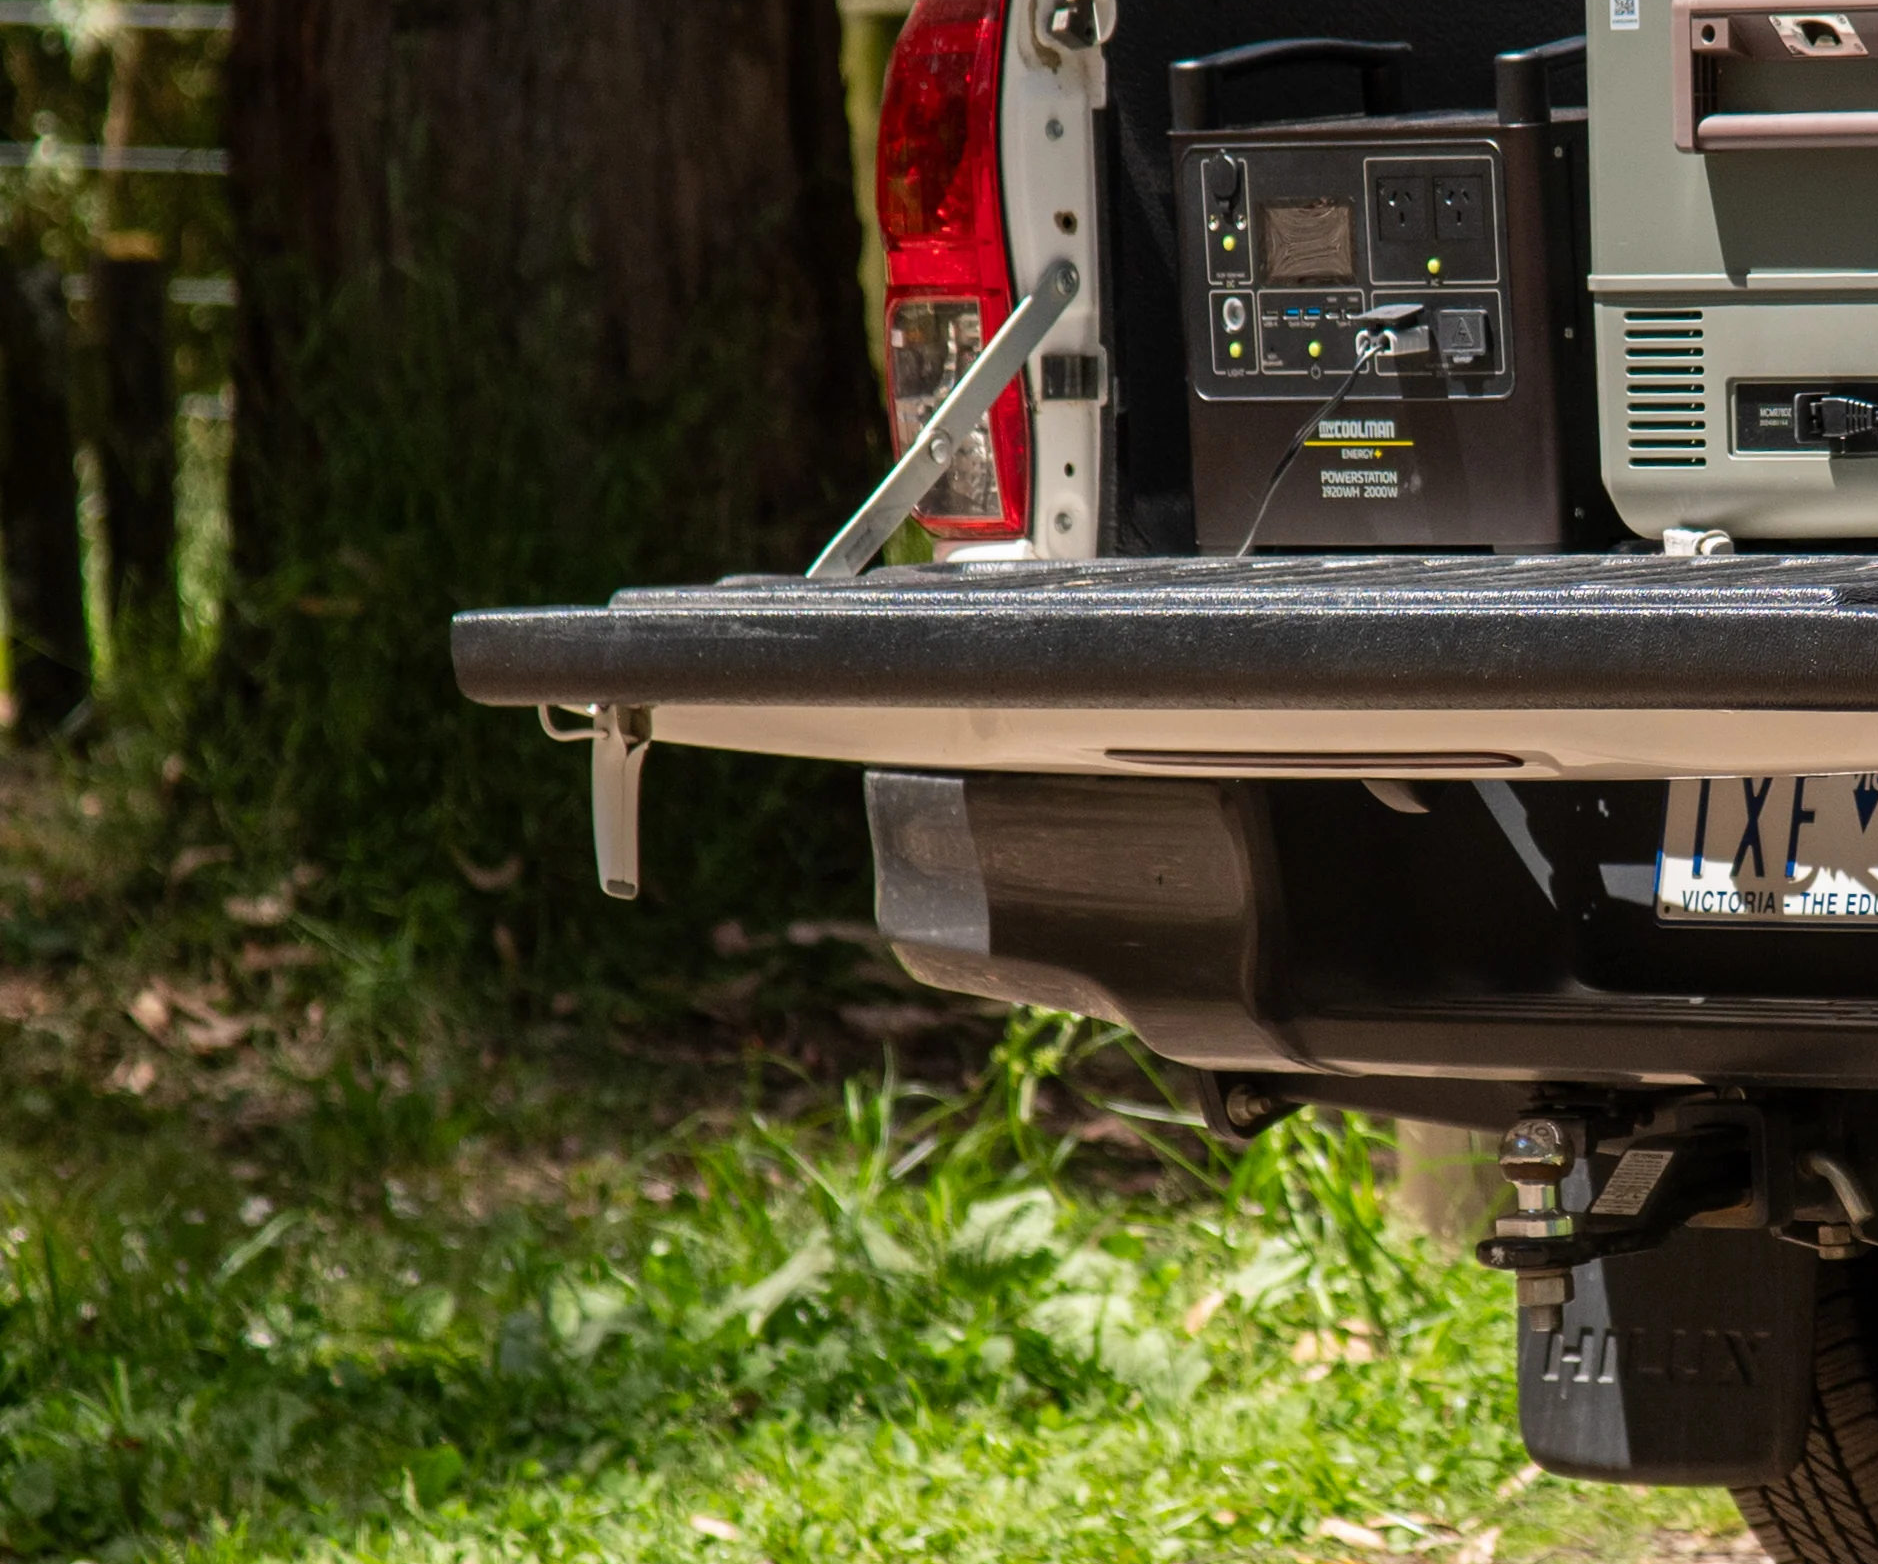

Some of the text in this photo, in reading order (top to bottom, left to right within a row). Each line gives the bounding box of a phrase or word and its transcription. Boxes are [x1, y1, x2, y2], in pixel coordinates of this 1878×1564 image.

[1319, 420, 1395, 439] MYCOOLMAN
[1341, 448, 1374, 460] ENERGY
[1321, 471, 1398, 484] POWERSTATION
[1364, 486, 1398, 498] 2000W
[1682, 890, 1777, 914] VICTORIA
[1800, 892, 1838, 915] THE
